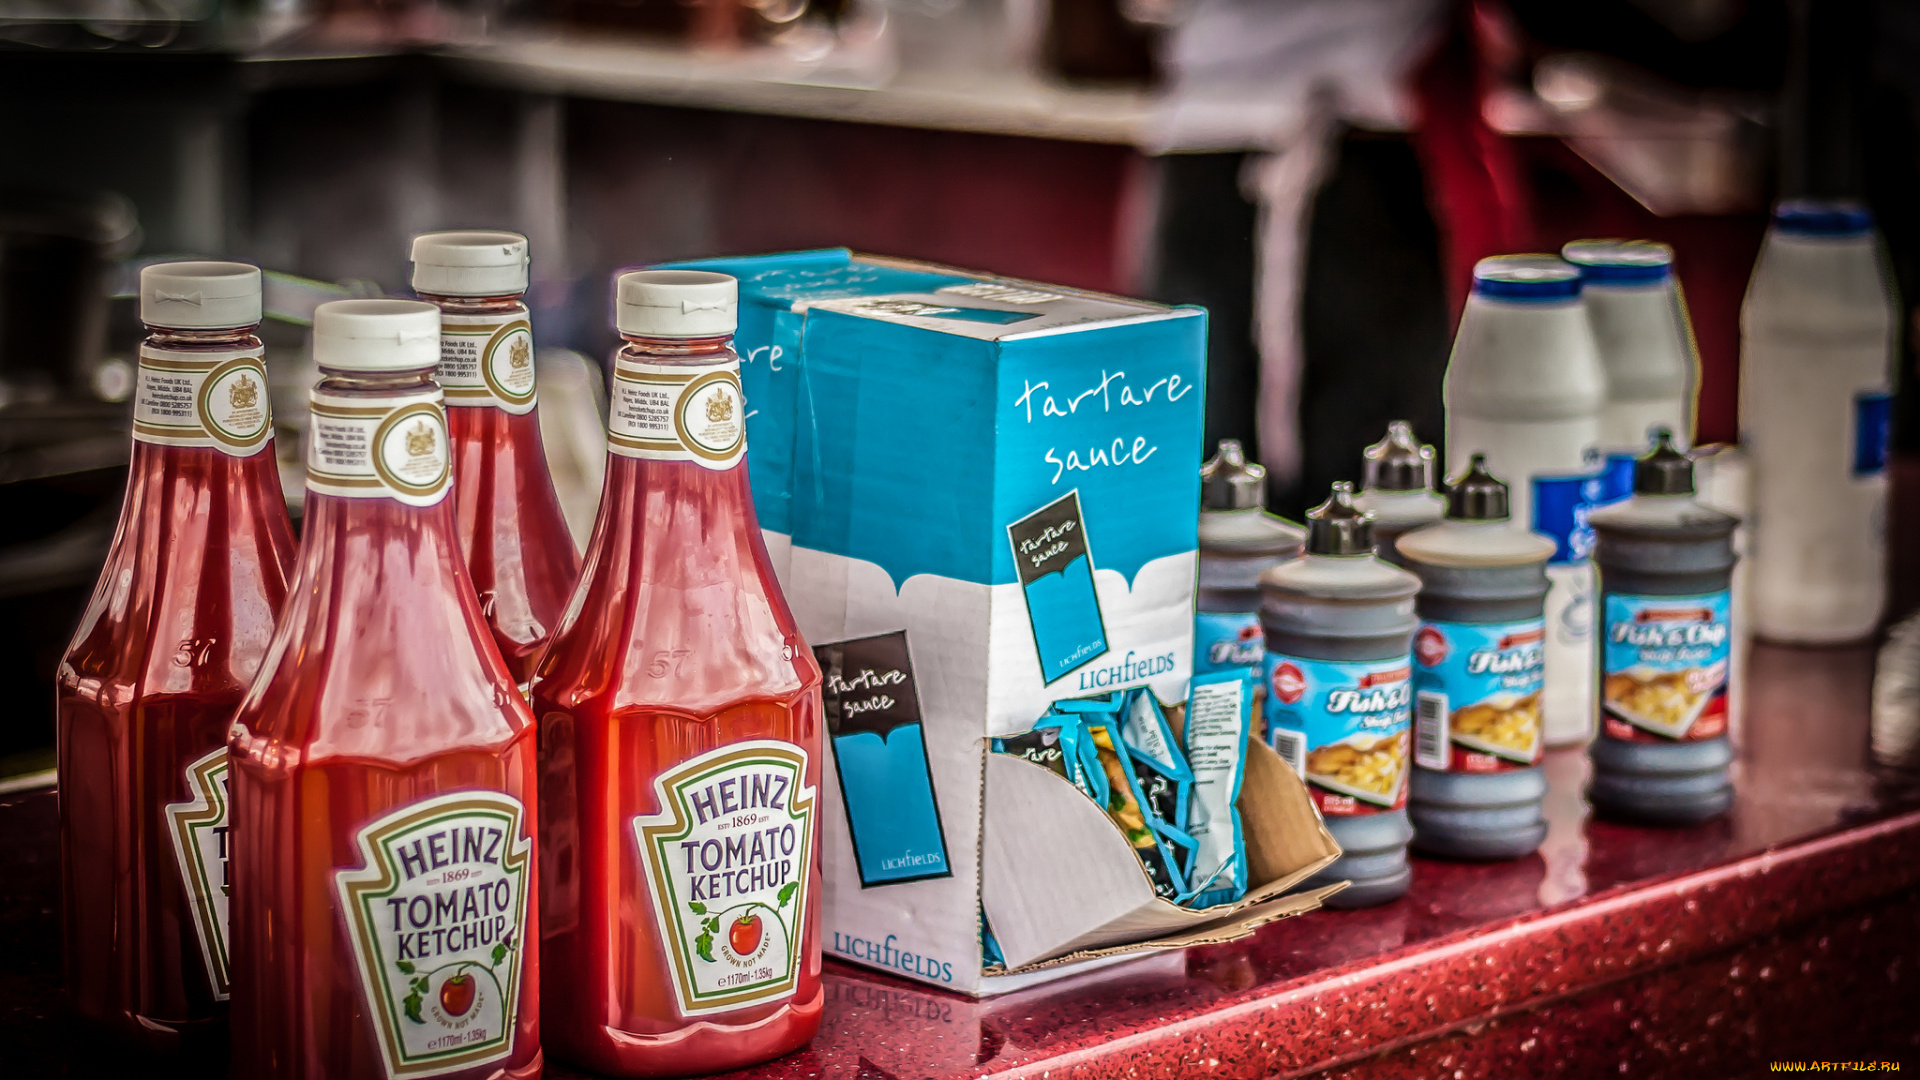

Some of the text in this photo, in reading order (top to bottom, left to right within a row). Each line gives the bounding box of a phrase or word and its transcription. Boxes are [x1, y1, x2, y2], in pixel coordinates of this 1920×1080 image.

[1015, 369, 1192, 423] tartare
[1045, 436, 1157, 484] sauce
[1020, 520, 1076, 555] tartare
[1032, 541, 1069, 568] sauce
[647, 649, 691, 679] 57
[1468, 652, 1524, 674] Fish
[828, 668, 907, 696] tartare
[844, 695, 895, 720] sauce
[1327, 690, 1386, 713] Fish
[690, 773, 789, 824] HEINZ
[733, 813, 757, 828] 1869
[397, 826, 503, 880] HEINZ
[680, 822, 796, 873] TOMATO
[442, 868, 470, 884] 1869
[690, 858, 792, 901] KETCHUP
[386, 877, 511, 932] TOMATO
[397, 914, 506, 960] KETCHUP
[721, 945, 741, 967] GROWN
[743, 957, 756, 967] NOT
[431, 1006, 453, 1029] GROWN
[454, 1018, 469, 1029] NOT
